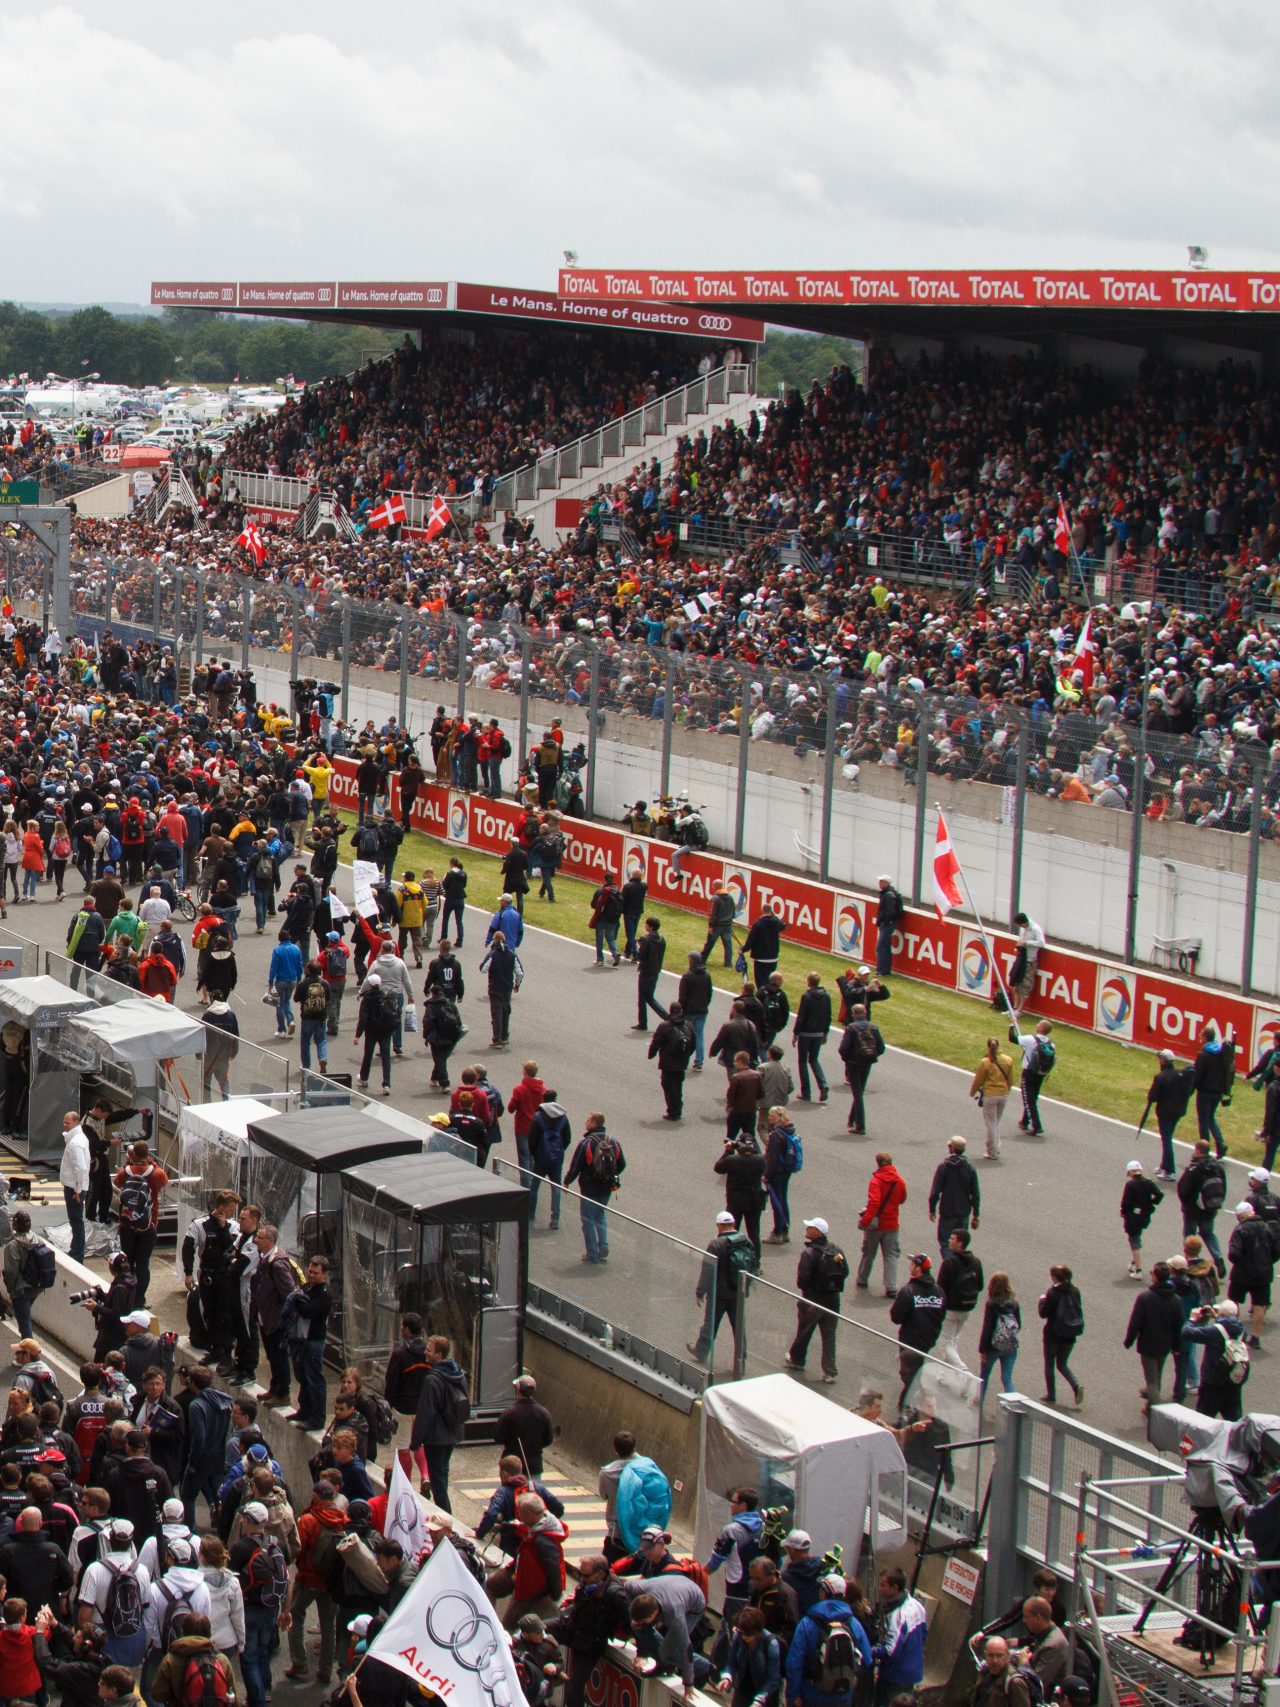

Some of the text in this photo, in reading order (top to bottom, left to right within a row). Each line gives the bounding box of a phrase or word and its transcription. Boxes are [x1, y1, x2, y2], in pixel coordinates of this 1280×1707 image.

[563, 274, 599, 293] TOTAL
[605, 274, 643, 295] TOTAL
[649, 275, 689, 296] TOTAL
[694, 276, 737, 297] TOTAL
[744, 276, 789, 297] TOTAL
[796, 276, 843, 298] TOTAL
[850, 276, 899, 298] TOTAL
[907, 276, 960, 298] TOTAL
[969, 276, 1024, 299] TOTAL
[1033, 276, 1090, 300] TOTAL
[1100, 277, 1161, 301] TOTAL
[1172, 277, 1237, 303] TOTAL
[154, 290, 219, 301] Le Mans. Home of quattro
[242, 290, 315, 301] Le Mans. Home of quattro
[342, 290, 424, 303] Le Mans. Home of quattro
[490, 293, 689, 326] Le Mans. Home of quattro
[105, 447, 119, 458] 22
[327, 768, 360, 797] TOTA
[396, 786, 445, 823] TAL
[474, 807, 516, 842] TOTA
[562, 832, 618, 874] TOTAL
[653, 856, 714, 900] TOTAL
[756, 885, 828, 935] TOTAL
[872, 917, 952, 970] OTAL
[443, 967, 453, 981] 10
[1001, 952, 1089, 1010] TTAL
[913, 1295, 943, 1305] KooGa
[948, 1560, 977, 1583] INTERDICTION
[398, 1646, 456, 1697] Audi
[585, 1660, 638, 1707] OTO
